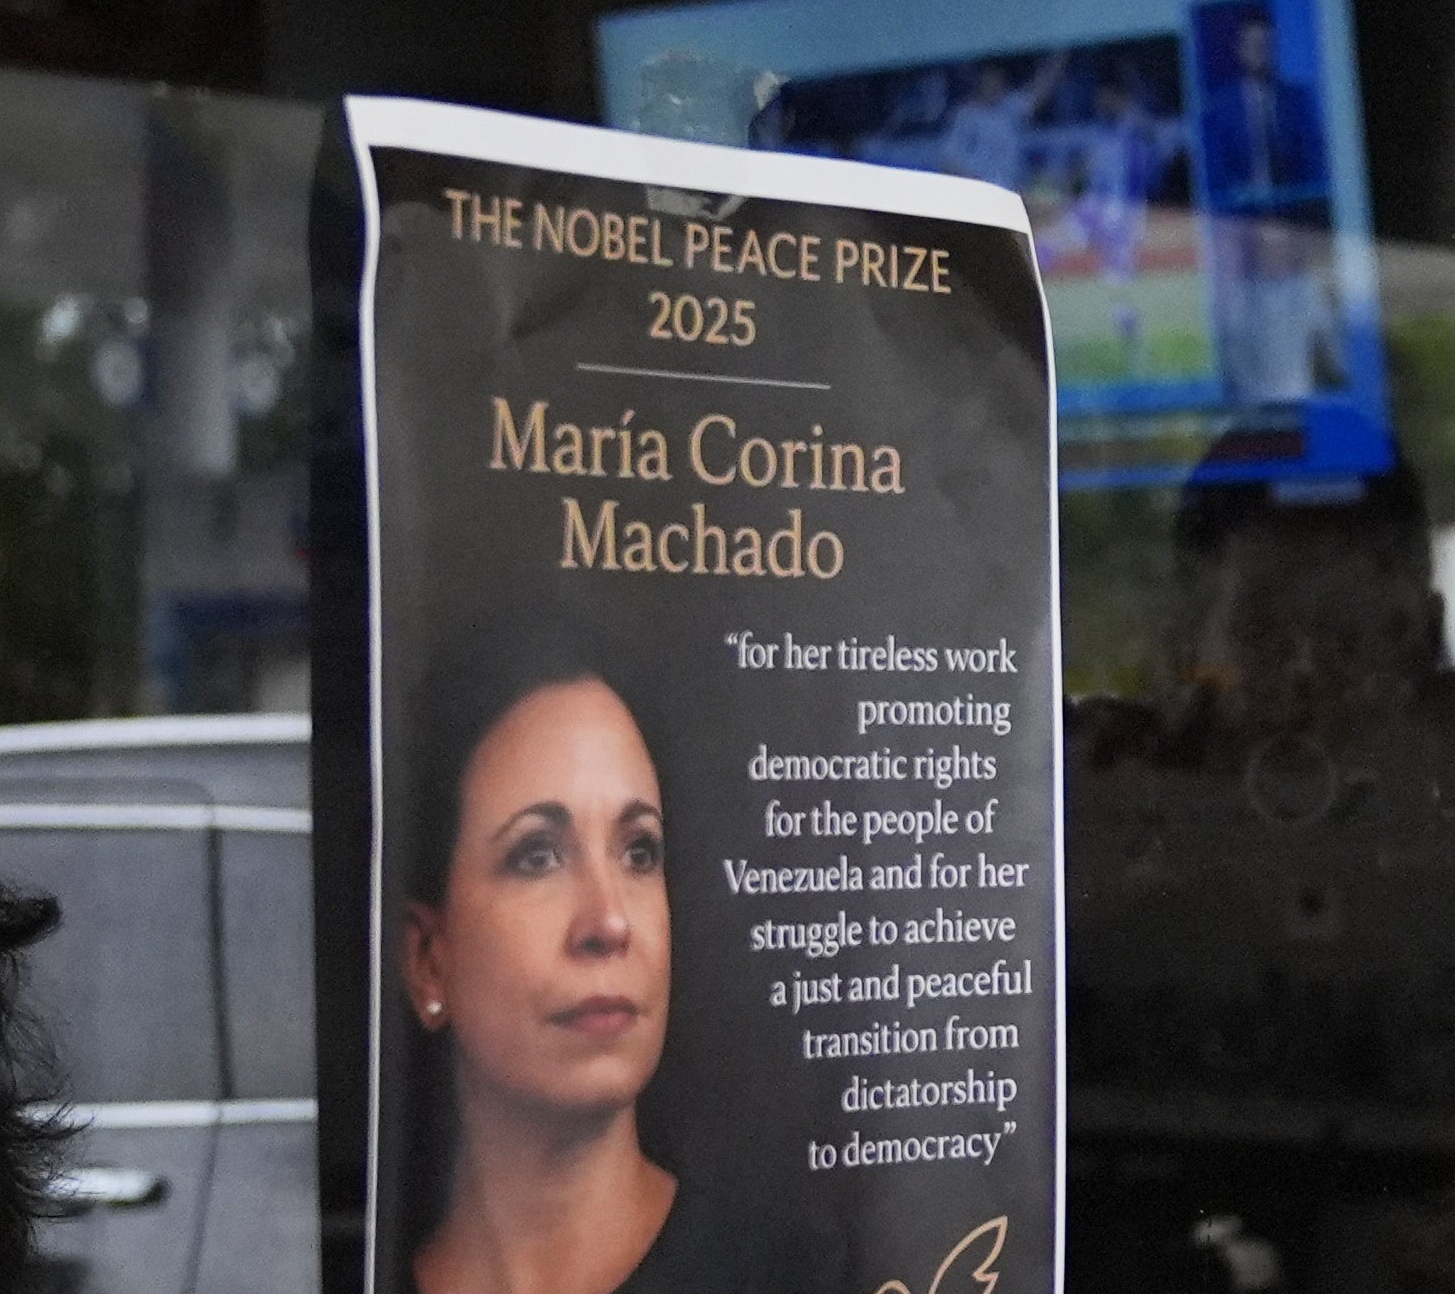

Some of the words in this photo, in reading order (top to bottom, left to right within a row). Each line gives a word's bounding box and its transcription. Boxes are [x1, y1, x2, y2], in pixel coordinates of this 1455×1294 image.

[444, 188, 523, 247] THE
[532, 204, 673, 269] NOBEL
[684, 223, 821, 281] PEACE
[834, 239, 952, 295] PRIZE
[648, 291, 757, 346] 2025
[490, 396, 673, 483] María
[689, 413, 906, 495] Corina
[559, 497, 845, 580] Machado
[783, 632, 832, 670] her
[838, 634, 939, 673] tireless
[945, 637, 1018, 674] work
[857, 693, 1012, 736] promoting
[748, 743, 908, 782] democratic
[913, 745, 998, 789] rights
[763, 799, 806, 838] for
[810, 800, 858, 837] the
[863, 799, 959, 845] people
[964, 798, 1000, 835] of
[723, 854, 864, 895] Venezuela
[870, 852, 923, 890] and
[929, 852, 972, 889] for
[977, 852, 1031, 888] her
[750, 910, 863, 958] struggle
[869, 915, 898, 946] to
[904, 907, 1017, 944] achieve
[769, 981, 787, 1006] a
[792, 971, 844, 1015] just
[848, 963, 900, 1001] and
[906, 959, 1033, 1007] peaceful
[802, 1020, 938, 1060] transition
[944, 1015, 1020, 1053] from
[841, 1068, 1018, 1112] dictatorship
[807, 1139, 836, 1171] to
[843, 1120, 1017, 1167] democracy”
